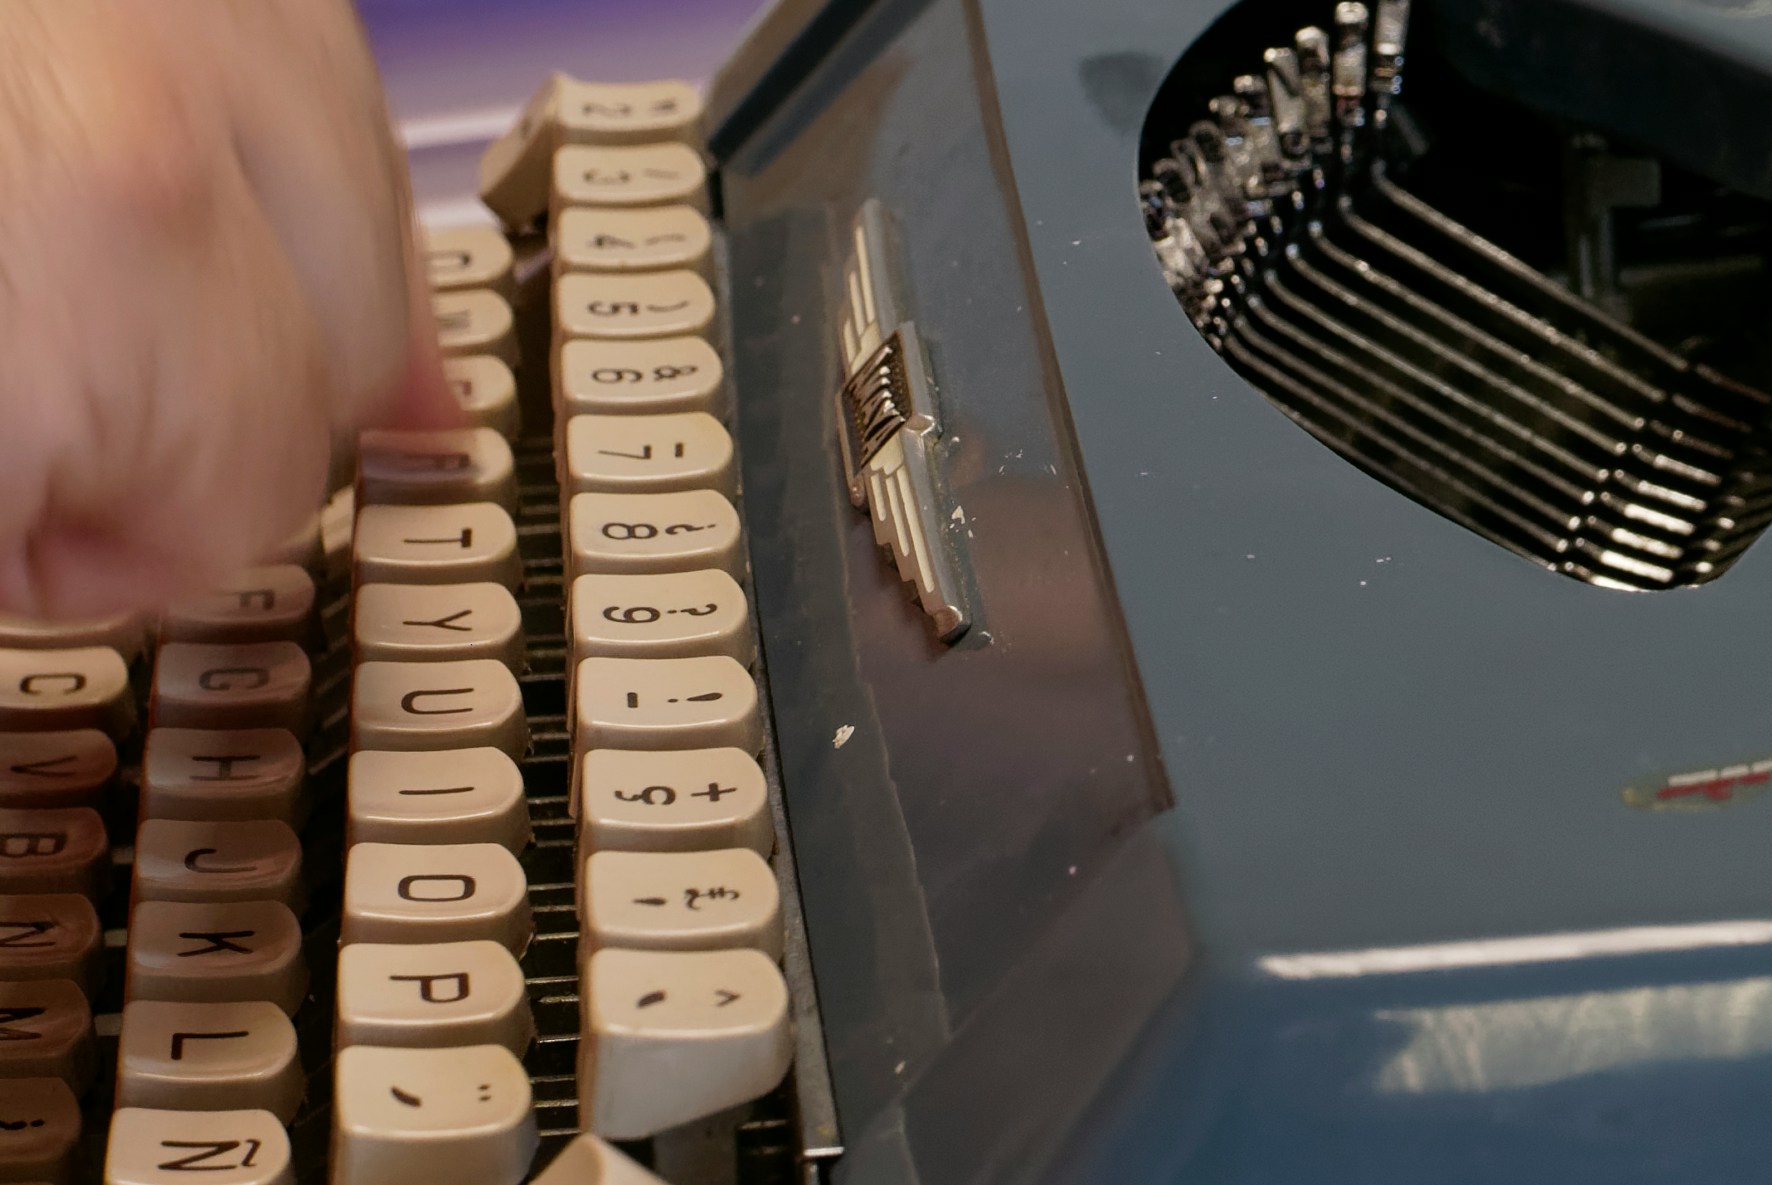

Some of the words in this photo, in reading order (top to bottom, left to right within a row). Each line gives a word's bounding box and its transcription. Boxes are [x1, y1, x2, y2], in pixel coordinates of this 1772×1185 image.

[587, 300, 641, 317] 5
[590, 367, 644, 385] 6
[597, 444, 652, 461] 7
[402, 527, 473, 548] T
[601, 522, 659, 541] 8
[402, 609, 473, 632] Y
[602, 605, 661, 624] 9
[666, 603, 718, 618] ?
[18, 672, 87, 695] C
[198, 667, 270, 692] G
[400, 687, 475, 716] U
[666, 692, 723, 704] !
[9, 754, 80, 778] V
[189, 754, 261, 782] H
[690, 781, 739, 803] +
[0, 831, 69, 859] B
[184, 847, 258, 874] J
[396, 873, 477, 903] O
[0, 920, 60, 948] N
[176, 930, 256, 958] K
[388, 971, 471, 1004] P
[170, 1030, 250, 1061] L
[156, 1138, 262, 1171] Ñ
